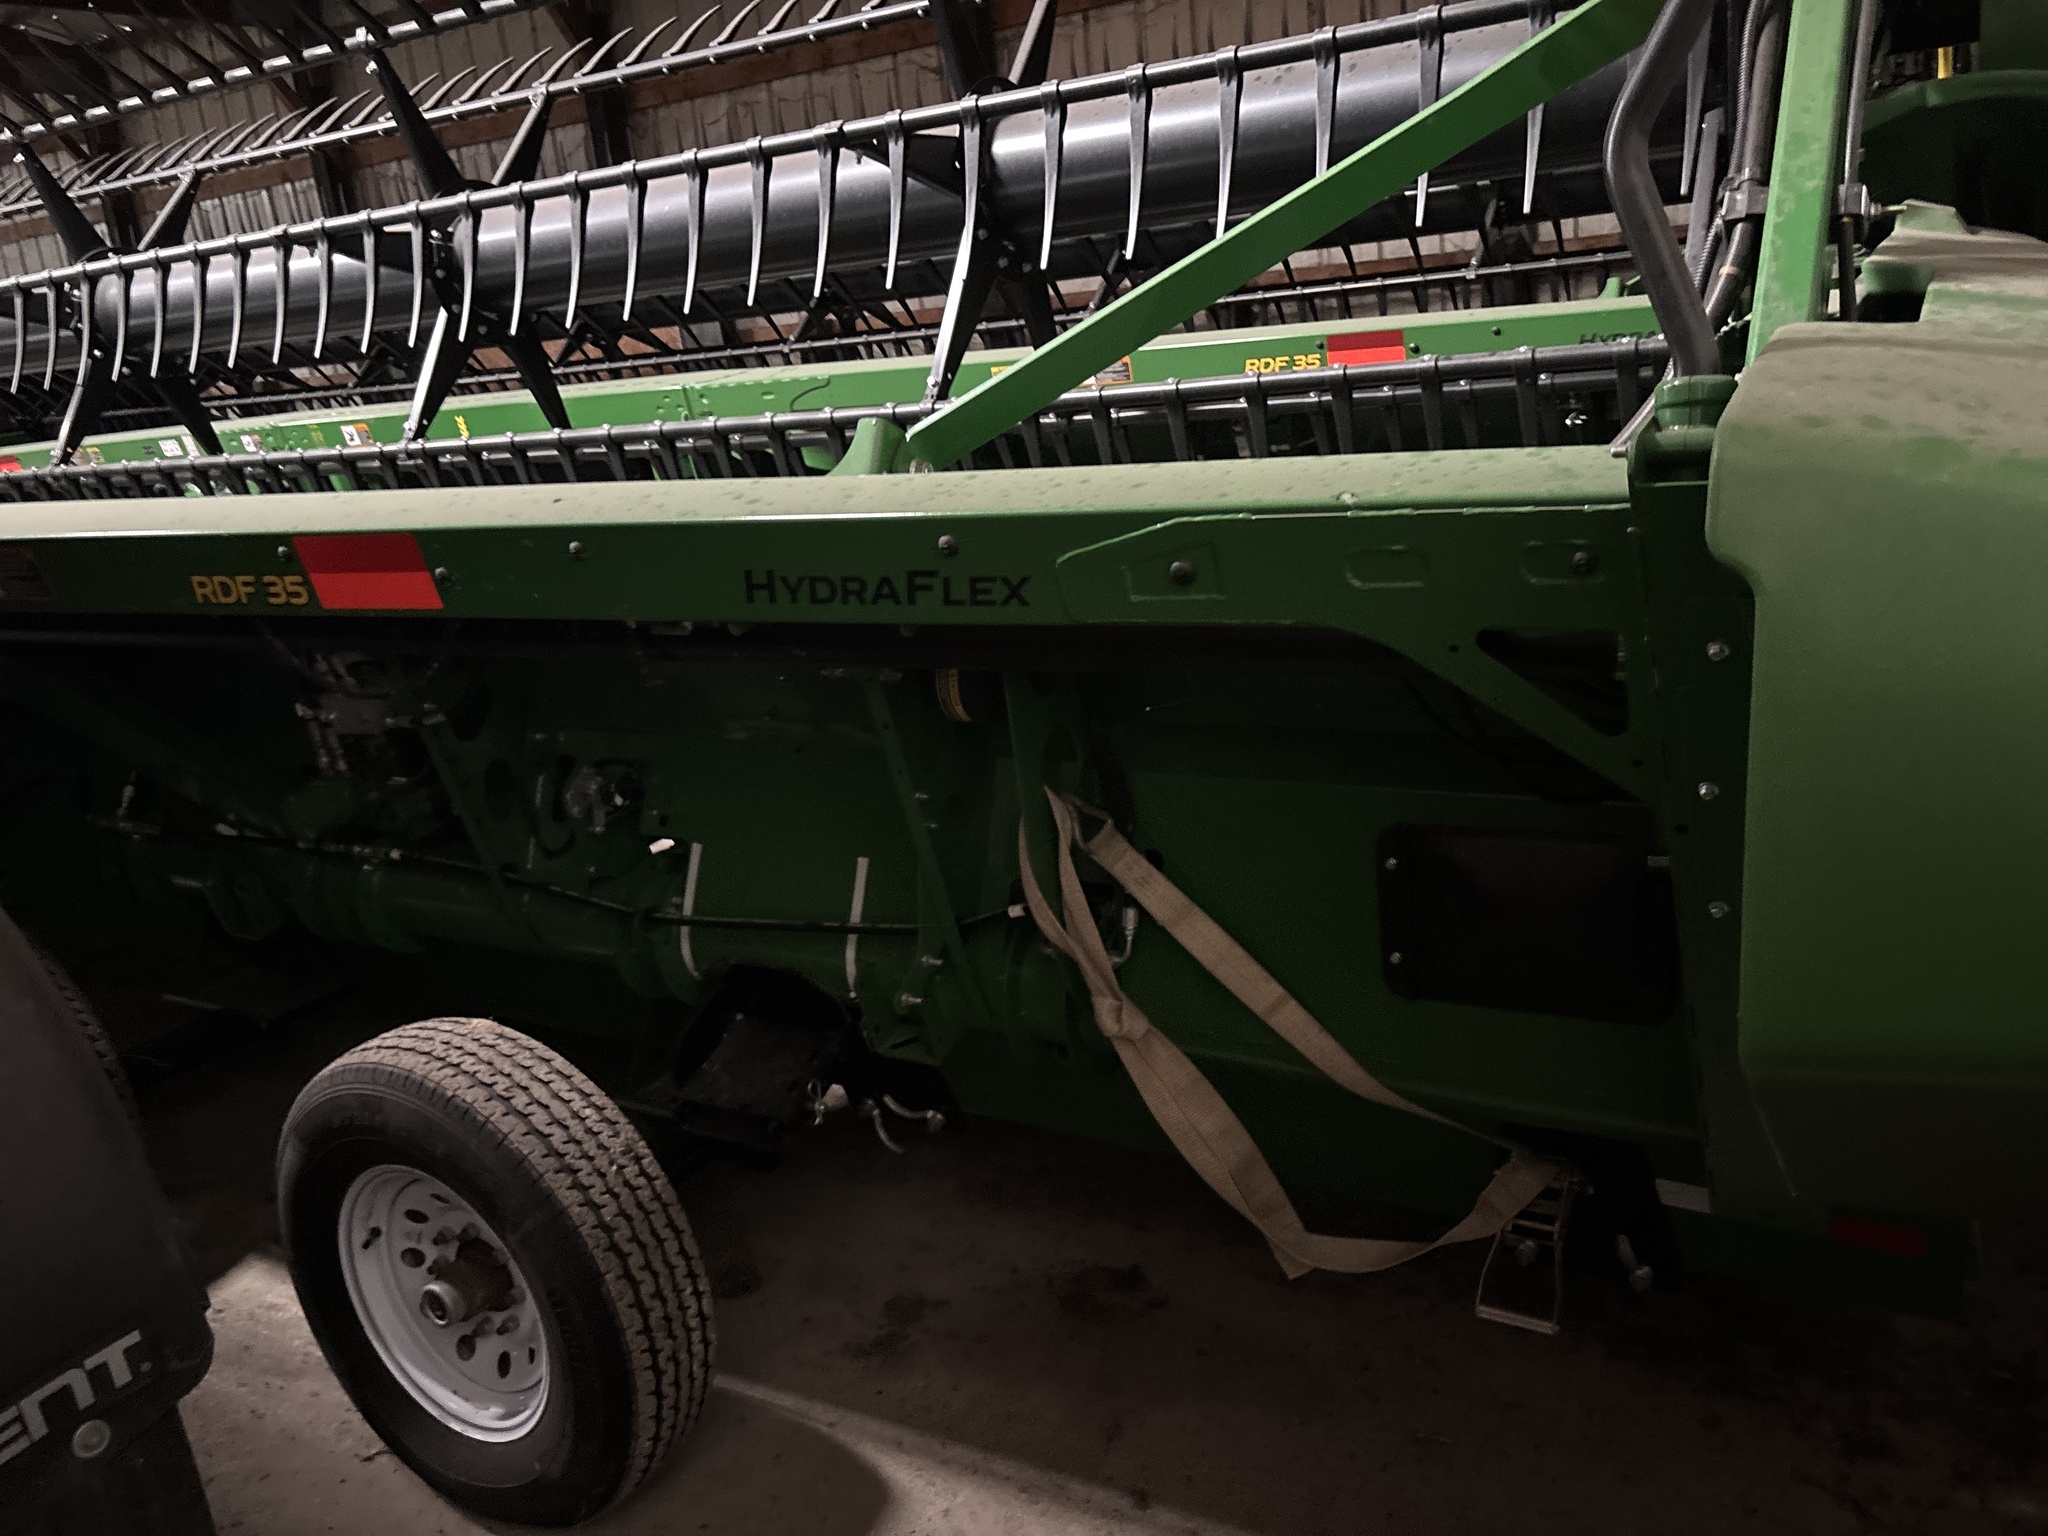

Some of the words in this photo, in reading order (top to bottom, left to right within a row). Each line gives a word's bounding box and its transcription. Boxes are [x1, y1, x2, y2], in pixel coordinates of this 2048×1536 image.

[1244, 356, 1290, 373] RDF
[1292, 353, 1321, 371] 35
[190, 575, 256, 605] RDF
[261, 575, 309, 605] 35
